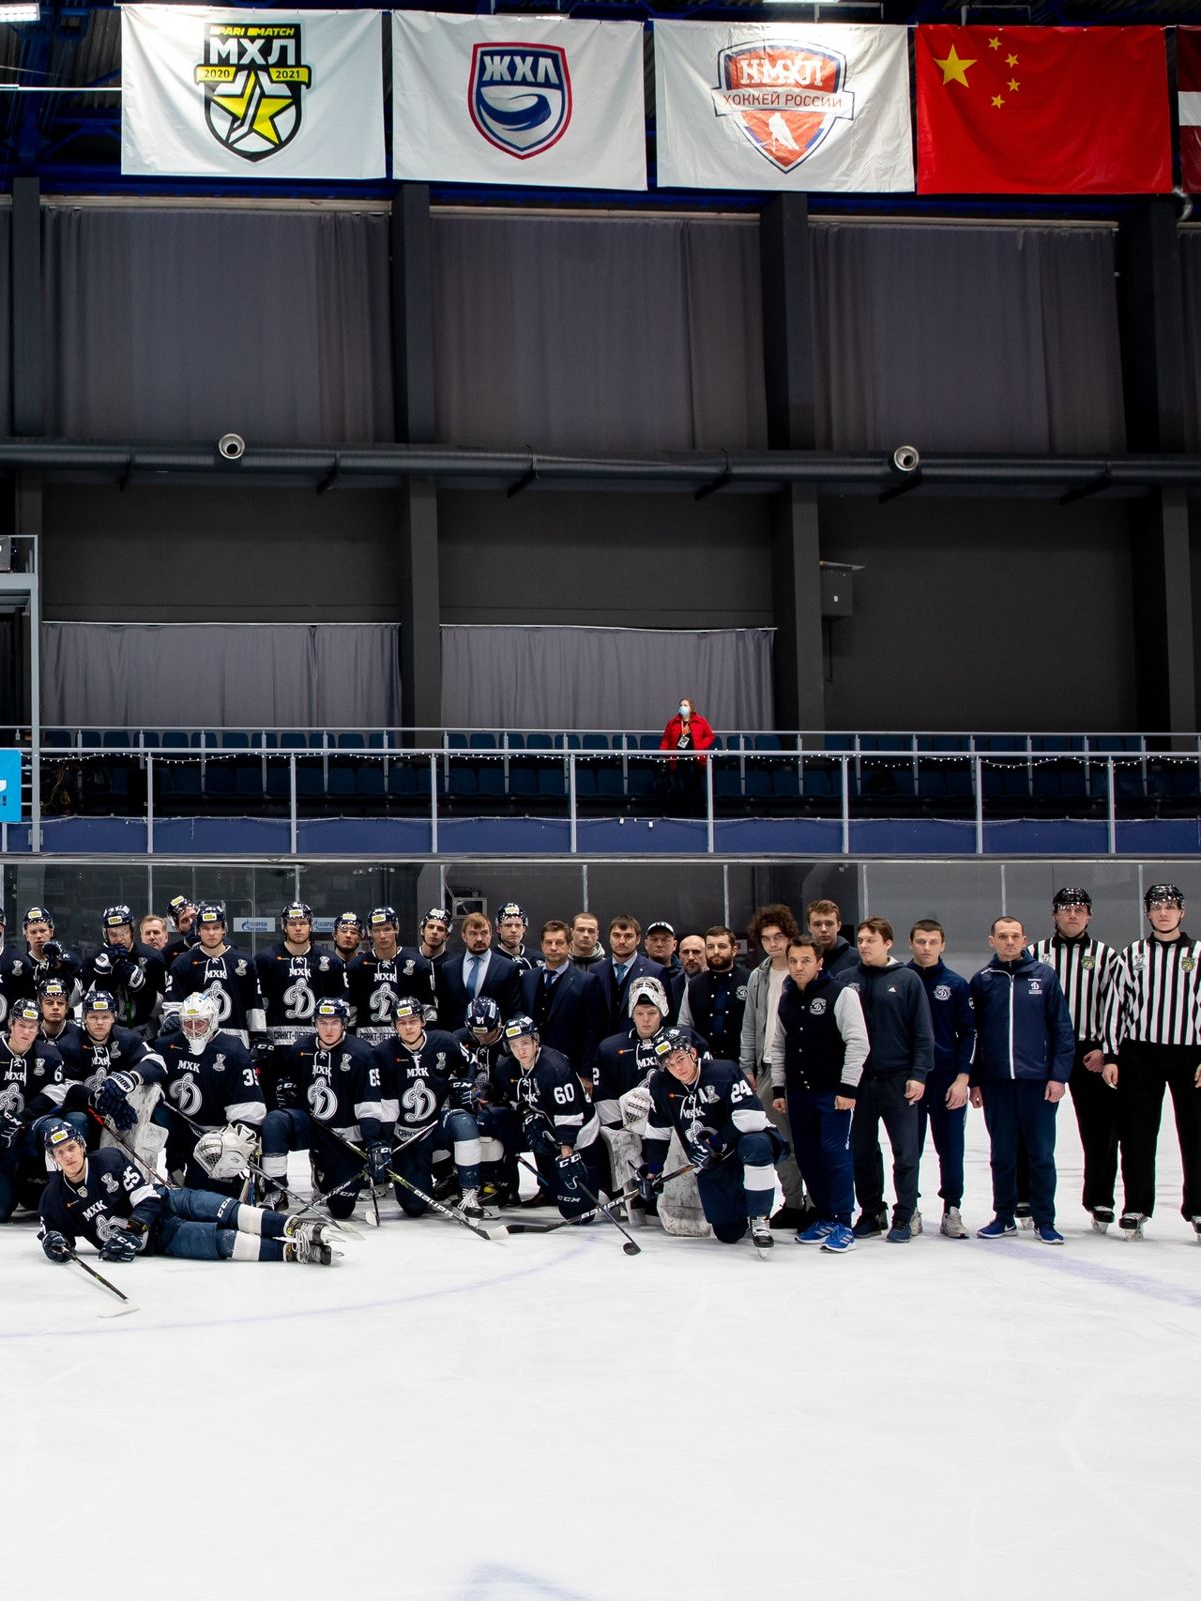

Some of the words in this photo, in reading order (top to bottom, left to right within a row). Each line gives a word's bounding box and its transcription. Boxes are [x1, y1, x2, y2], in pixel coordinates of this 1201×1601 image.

[252, 28, 295, 36] MATCH
[209, 37, 296, 65] МХЛ
[204, 68, 230, 79] 2020
[275, 70, 300, 79] 2021
[482, 55, 559, 84] ЖХЛ
[724, 91, 780, 106] ХОККЕЙ
[785, 94, 842, 108] РОССИИ
[177, 1060, 201, 1074] МХК
[406, 1067, 429, 1078] МХК
[553, 1083, 575, 1105] 60
[730, 1079, 753, 1104] 24
[123, 1165, 141, 1191] 25
[217, 1197, 233, 1218] CCM
[413, 1189, 454, 1217] BAUER
[557, 1195, 581, 1203] CCM
[82, 1200, 108, 1222] МХК
